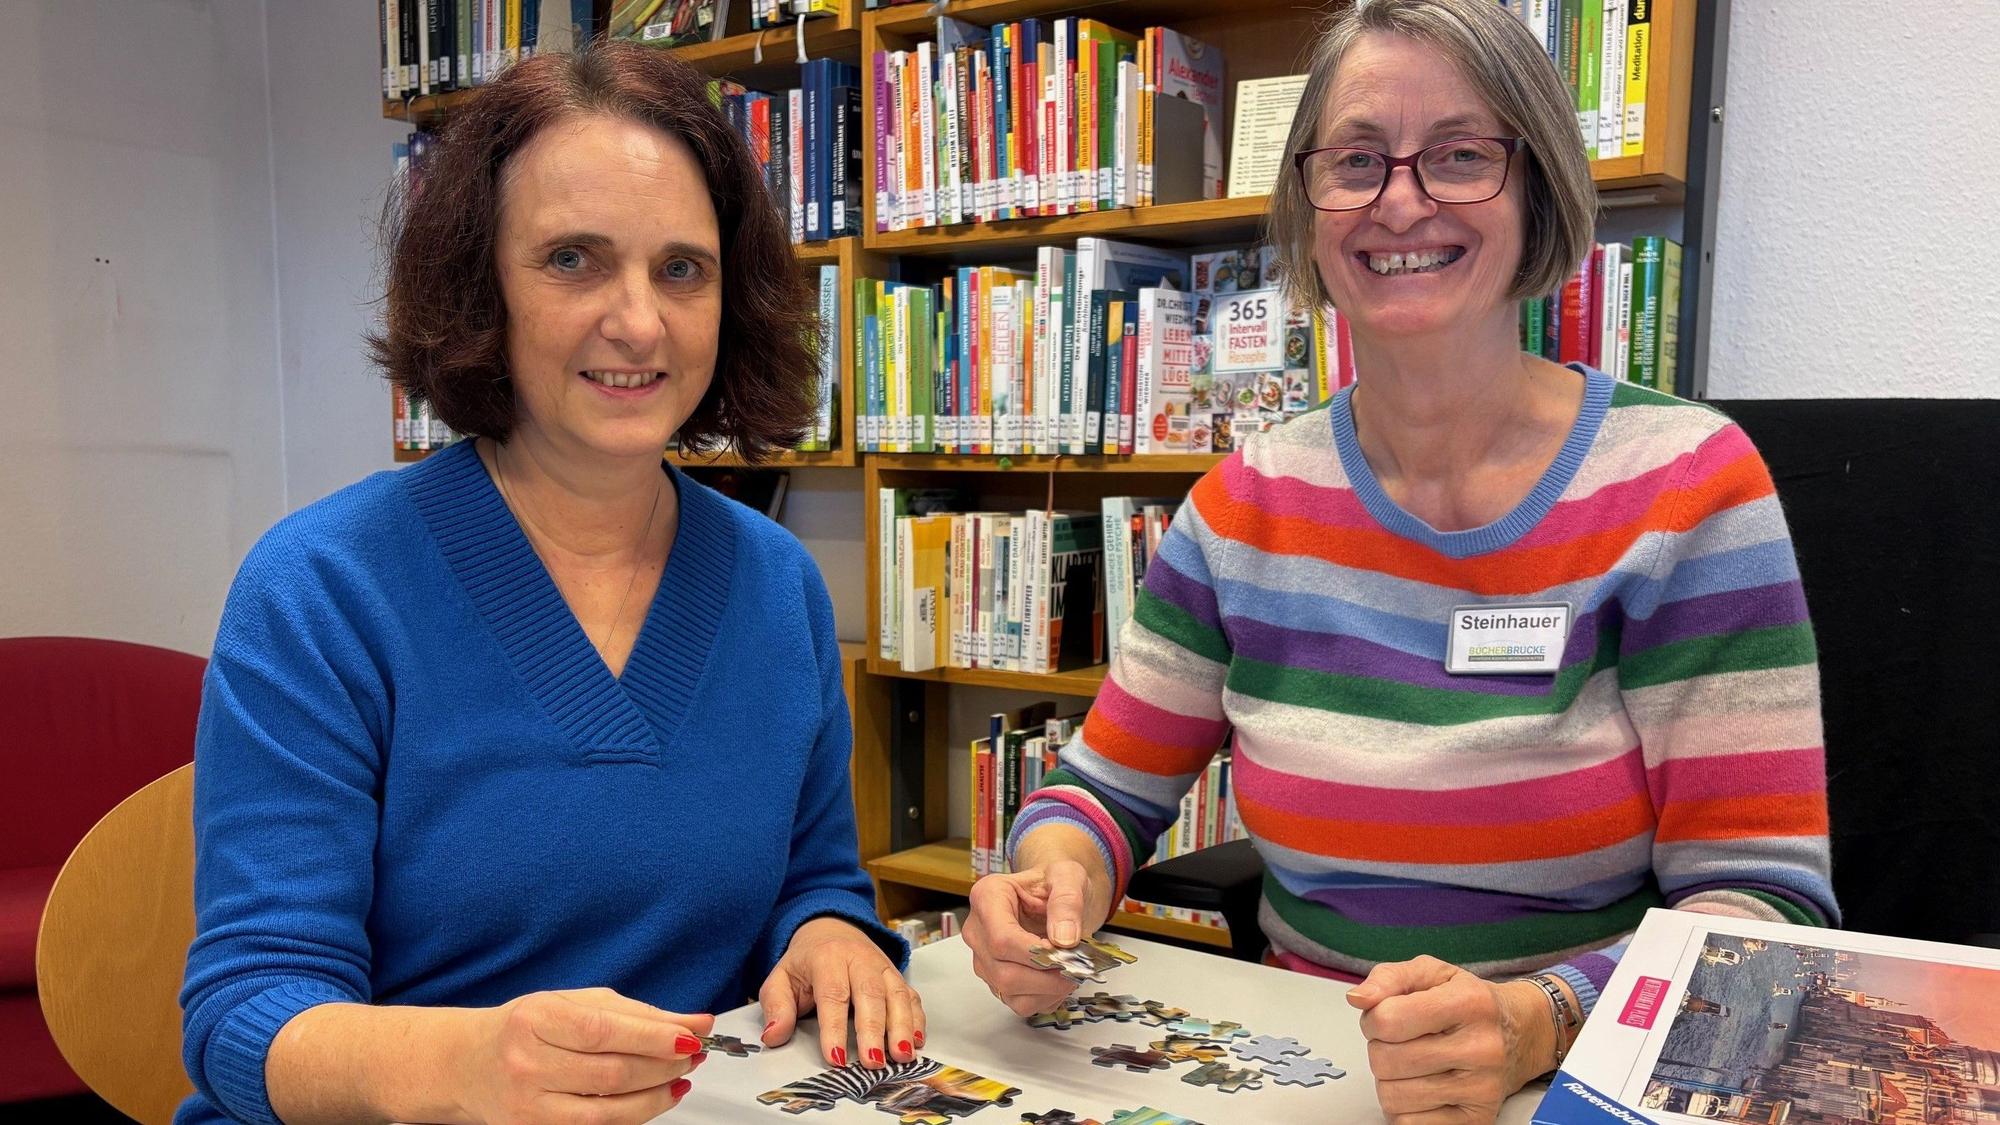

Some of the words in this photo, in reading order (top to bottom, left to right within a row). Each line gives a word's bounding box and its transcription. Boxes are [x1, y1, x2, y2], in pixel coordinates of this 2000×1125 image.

[1632, 30, 1643, 80] Meditation
[1080, 72, 1088, 104] schlank!
[775, 112, 783, 143] WETTER
[791, 108, 799, 132] WARM
[920, 66, 930, 164] MASSAGETECHNIKEN
[791, 135, 800, 156] EUCH
[1230, 299, 1267, 321] 365
[996, 312, 1008, 364] HEILEN
[1063, 326, 1074, 362] Healing
[1229, 321, 1267, 334] Intervall
[1229, 336, 1267, 350] FASTEN
[1634, 312, 1644, 350] GEHEIMNIS
[1229, 351, 1266, 364] Rezepte
[1106, 515, 1115, 552] GEHIRN
[1114, 518, 1122, 552] PSYCHE
[1108, 553, 1116, 594] GESUNDES
[1024, 585, 1032, 622] LIGHTSPEED
[1460, 614, 1560, 630] Steinhauer
[1008, 760, 1016, 792] gestresste
[1182, 809, 1192, 848] DEUTSCHLAND
